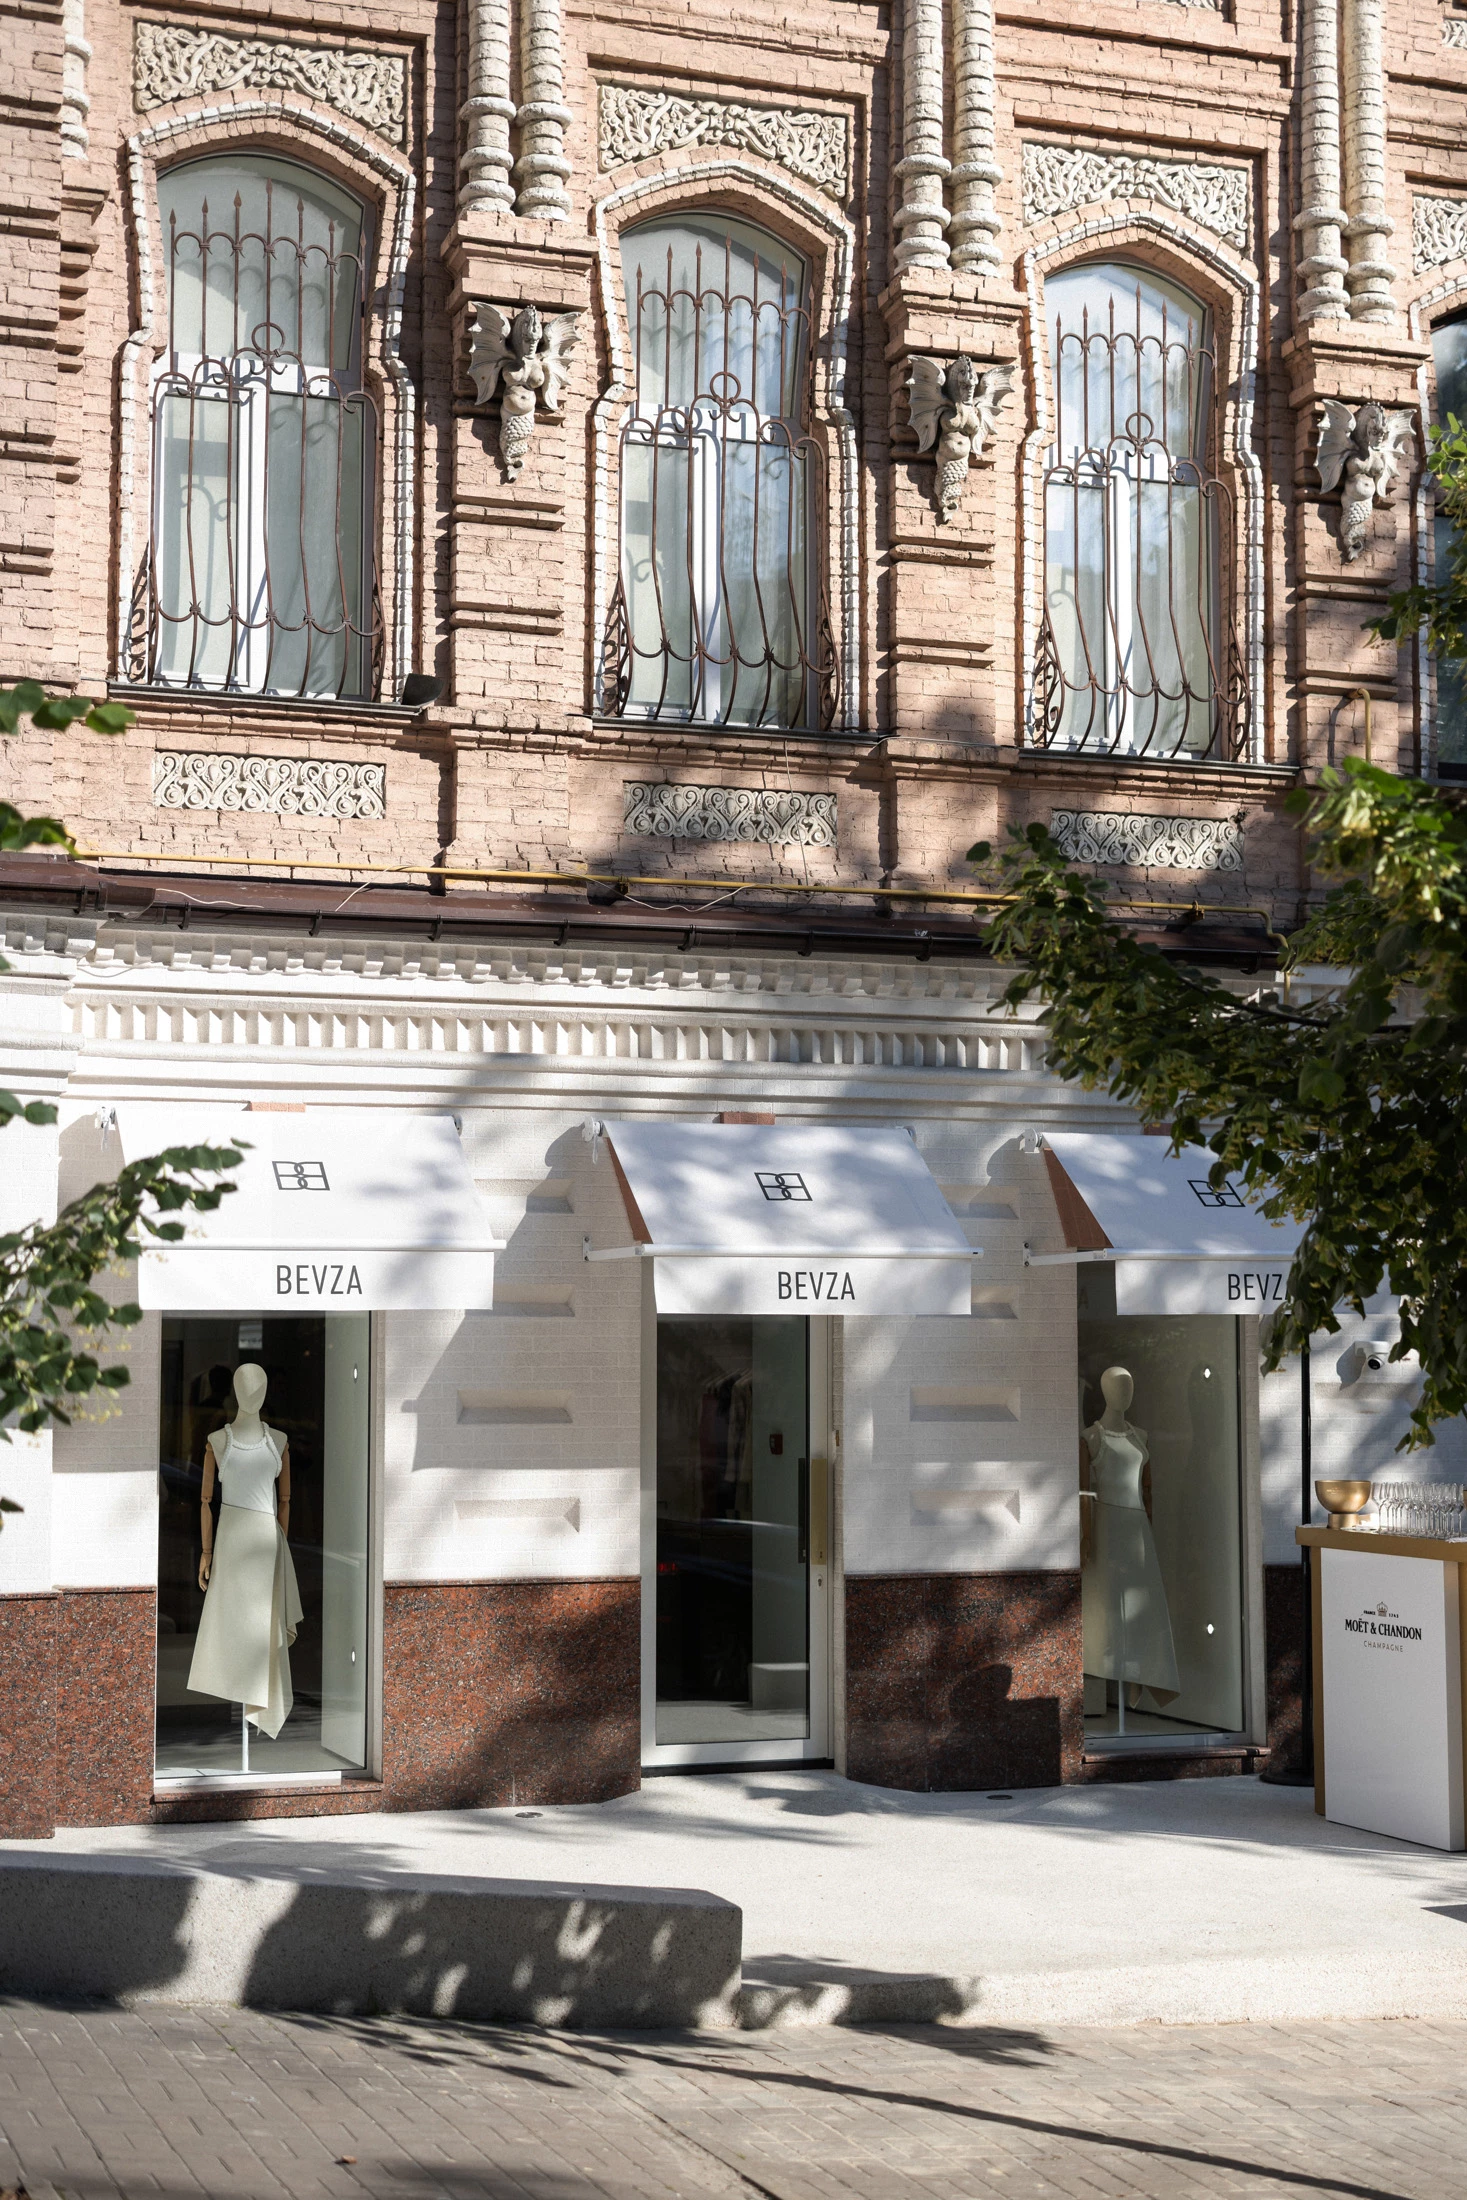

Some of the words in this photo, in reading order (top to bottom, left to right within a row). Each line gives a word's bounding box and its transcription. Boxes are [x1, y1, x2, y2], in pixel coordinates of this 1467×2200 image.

[276, 1264, 363, 1295] BEVZA
[778, 1271, 856, 1300] BEVZA
[1228, 1273, 1289, 1301] BEVZ
[1345, 1618, 1369, 1633] MOËT
[1370, 1621, 1377, 1635] &
[1378, 1624, 1422, 1640] CHANDON
[1363, 1641, 1403, 1652] CHAMPAGNE
